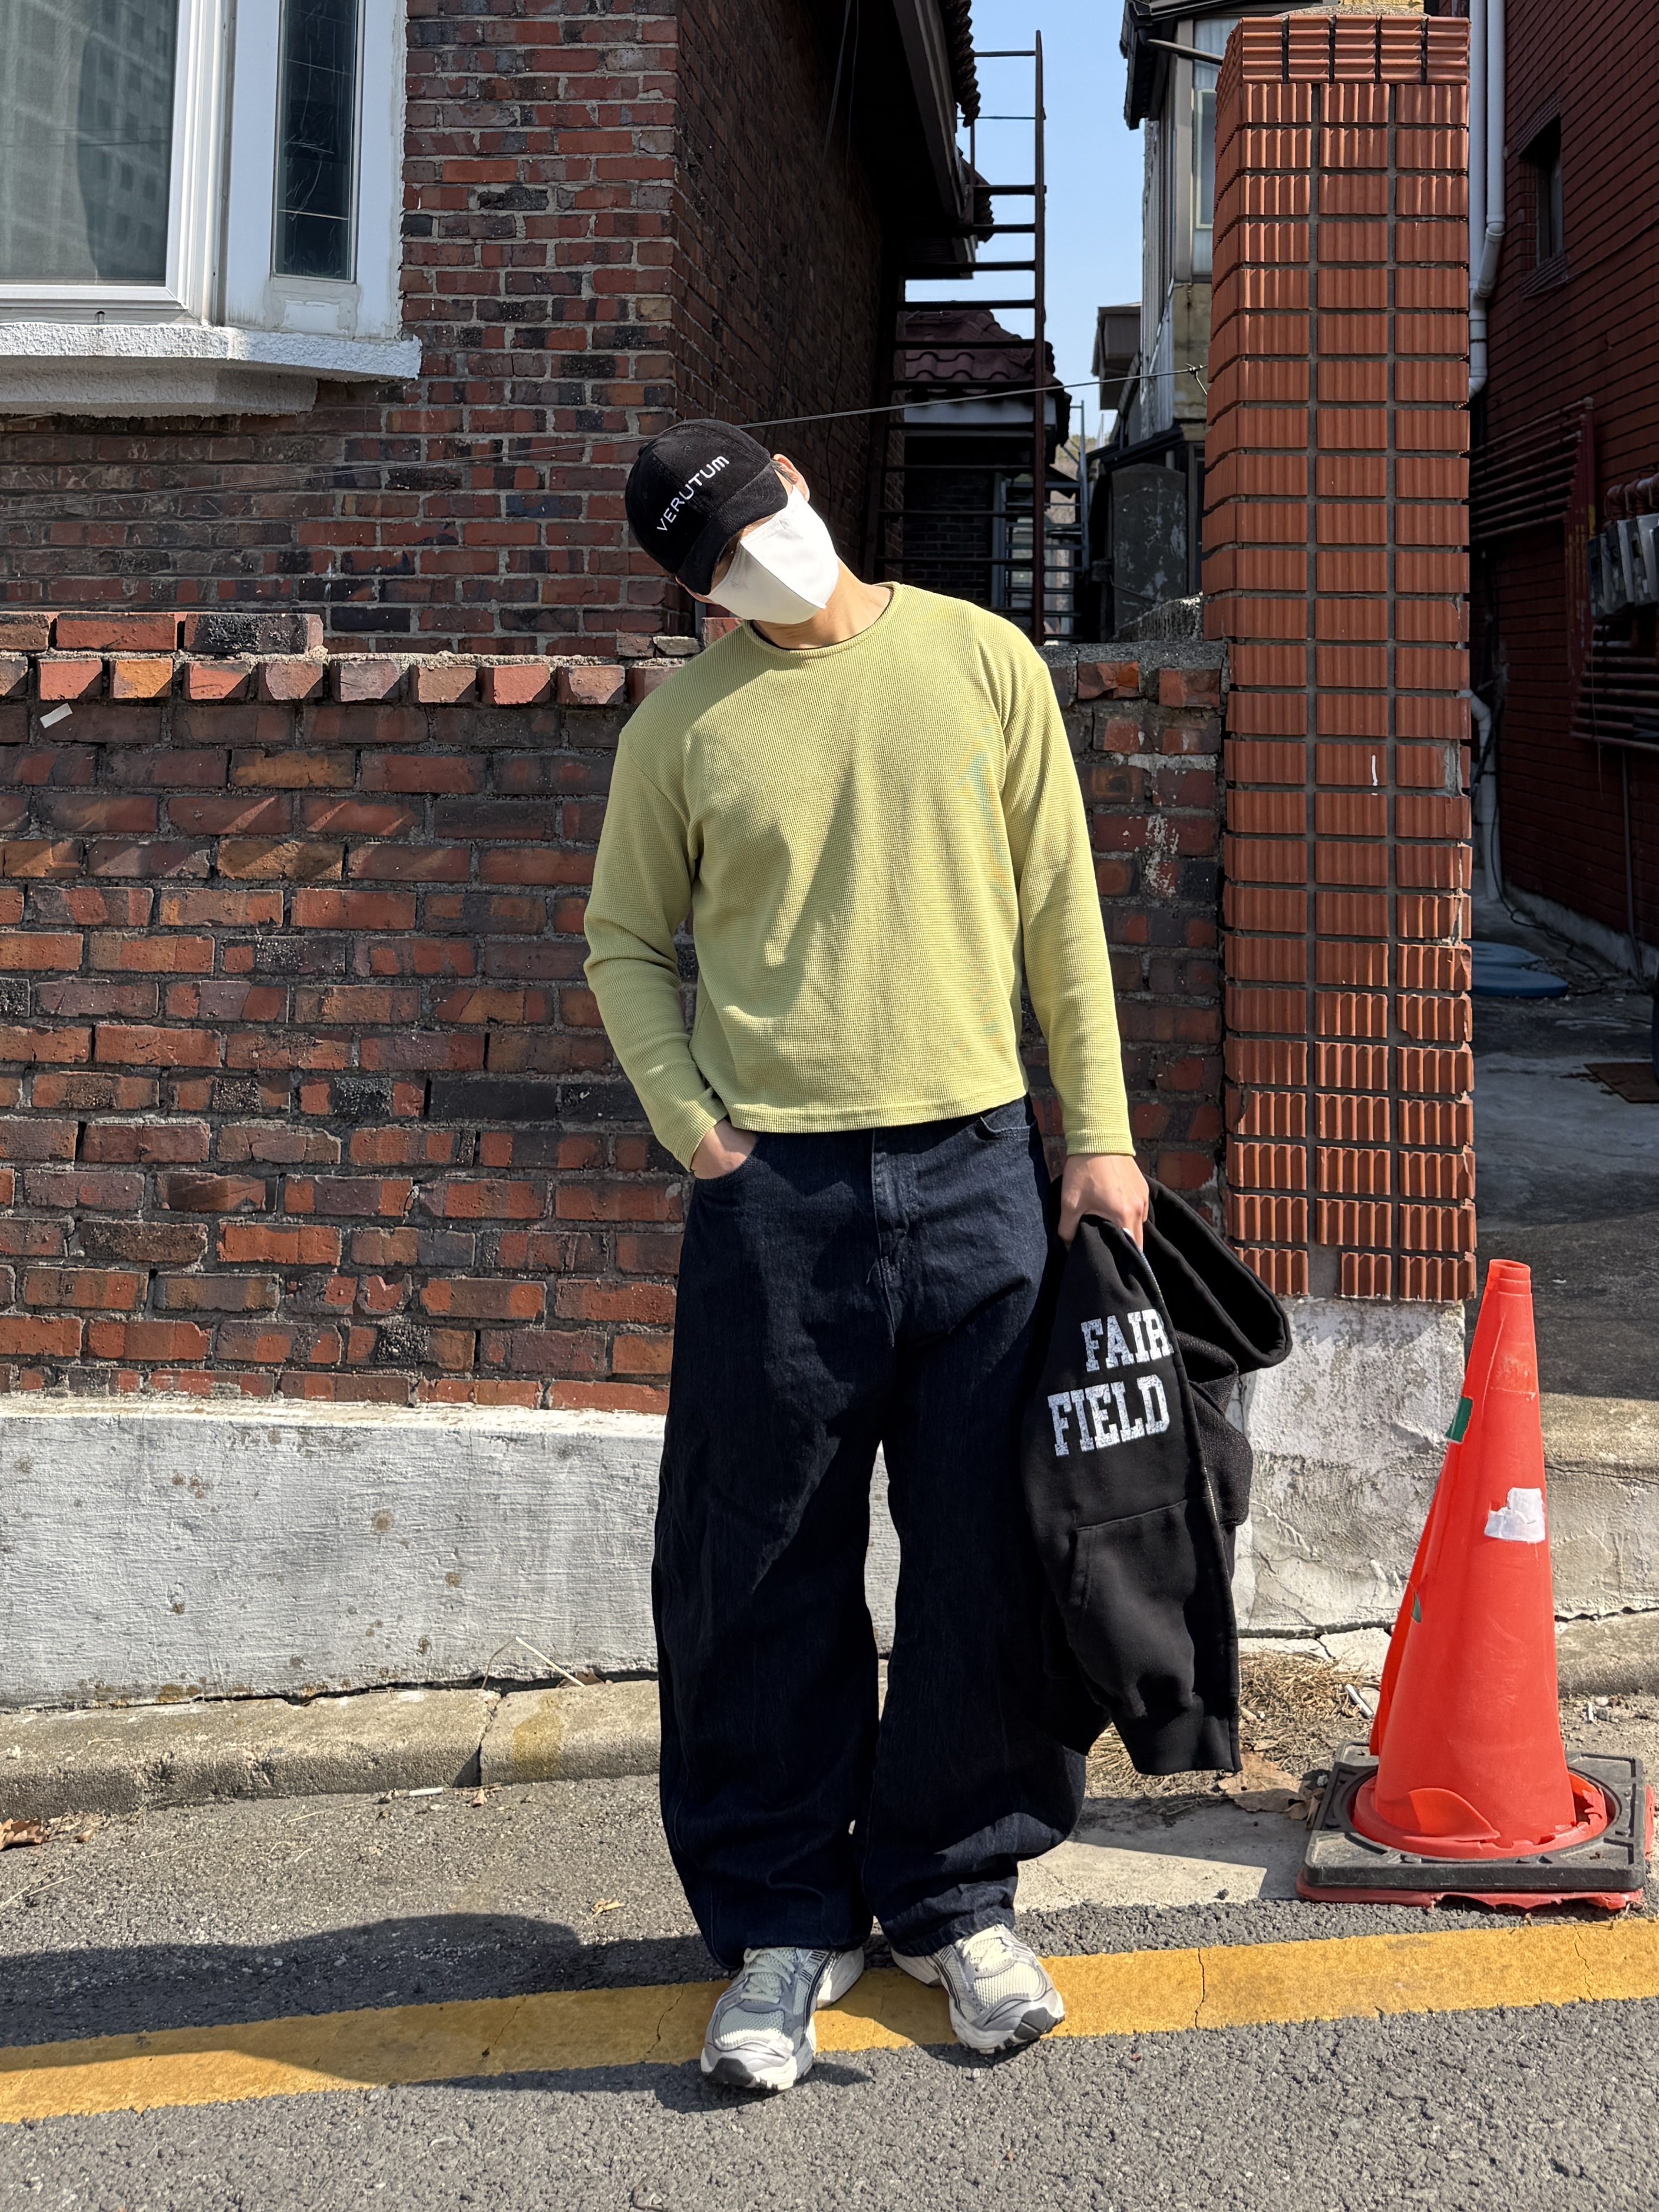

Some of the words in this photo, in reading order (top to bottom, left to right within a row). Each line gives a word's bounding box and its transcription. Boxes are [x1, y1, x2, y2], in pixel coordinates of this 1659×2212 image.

[657, 456, 730, 531] VERUTUM
[1081, 1309, 1174, 1372] FAIR
[1047, 1374, 1169, 1456] FIELD
